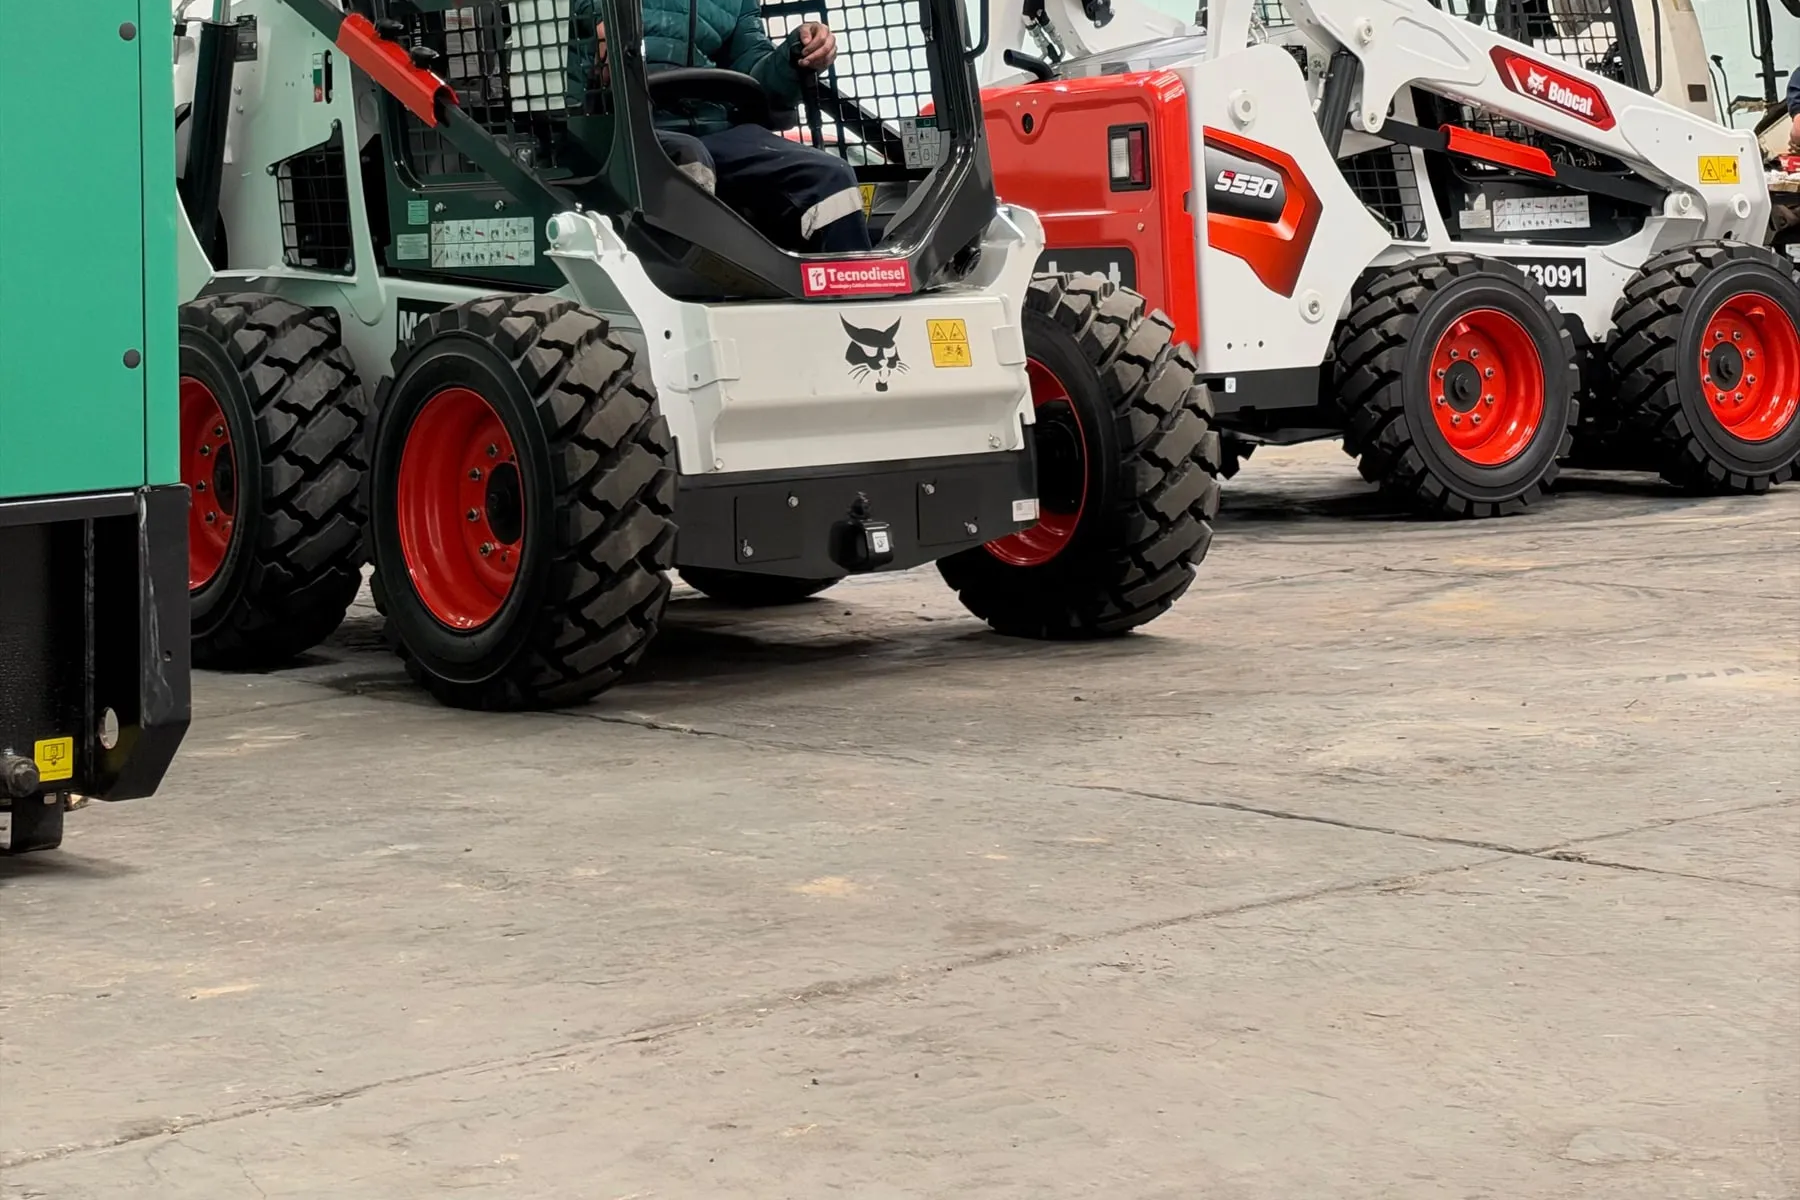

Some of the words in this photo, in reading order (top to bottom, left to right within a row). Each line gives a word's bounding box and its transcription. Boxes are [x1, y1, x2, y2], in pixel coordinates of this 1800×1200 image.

[1548, 81, 1594, 116] Bobcat
[1214, 170, 1279, 199] S530
[827, 266, 905, 282] Tecnodiesel
